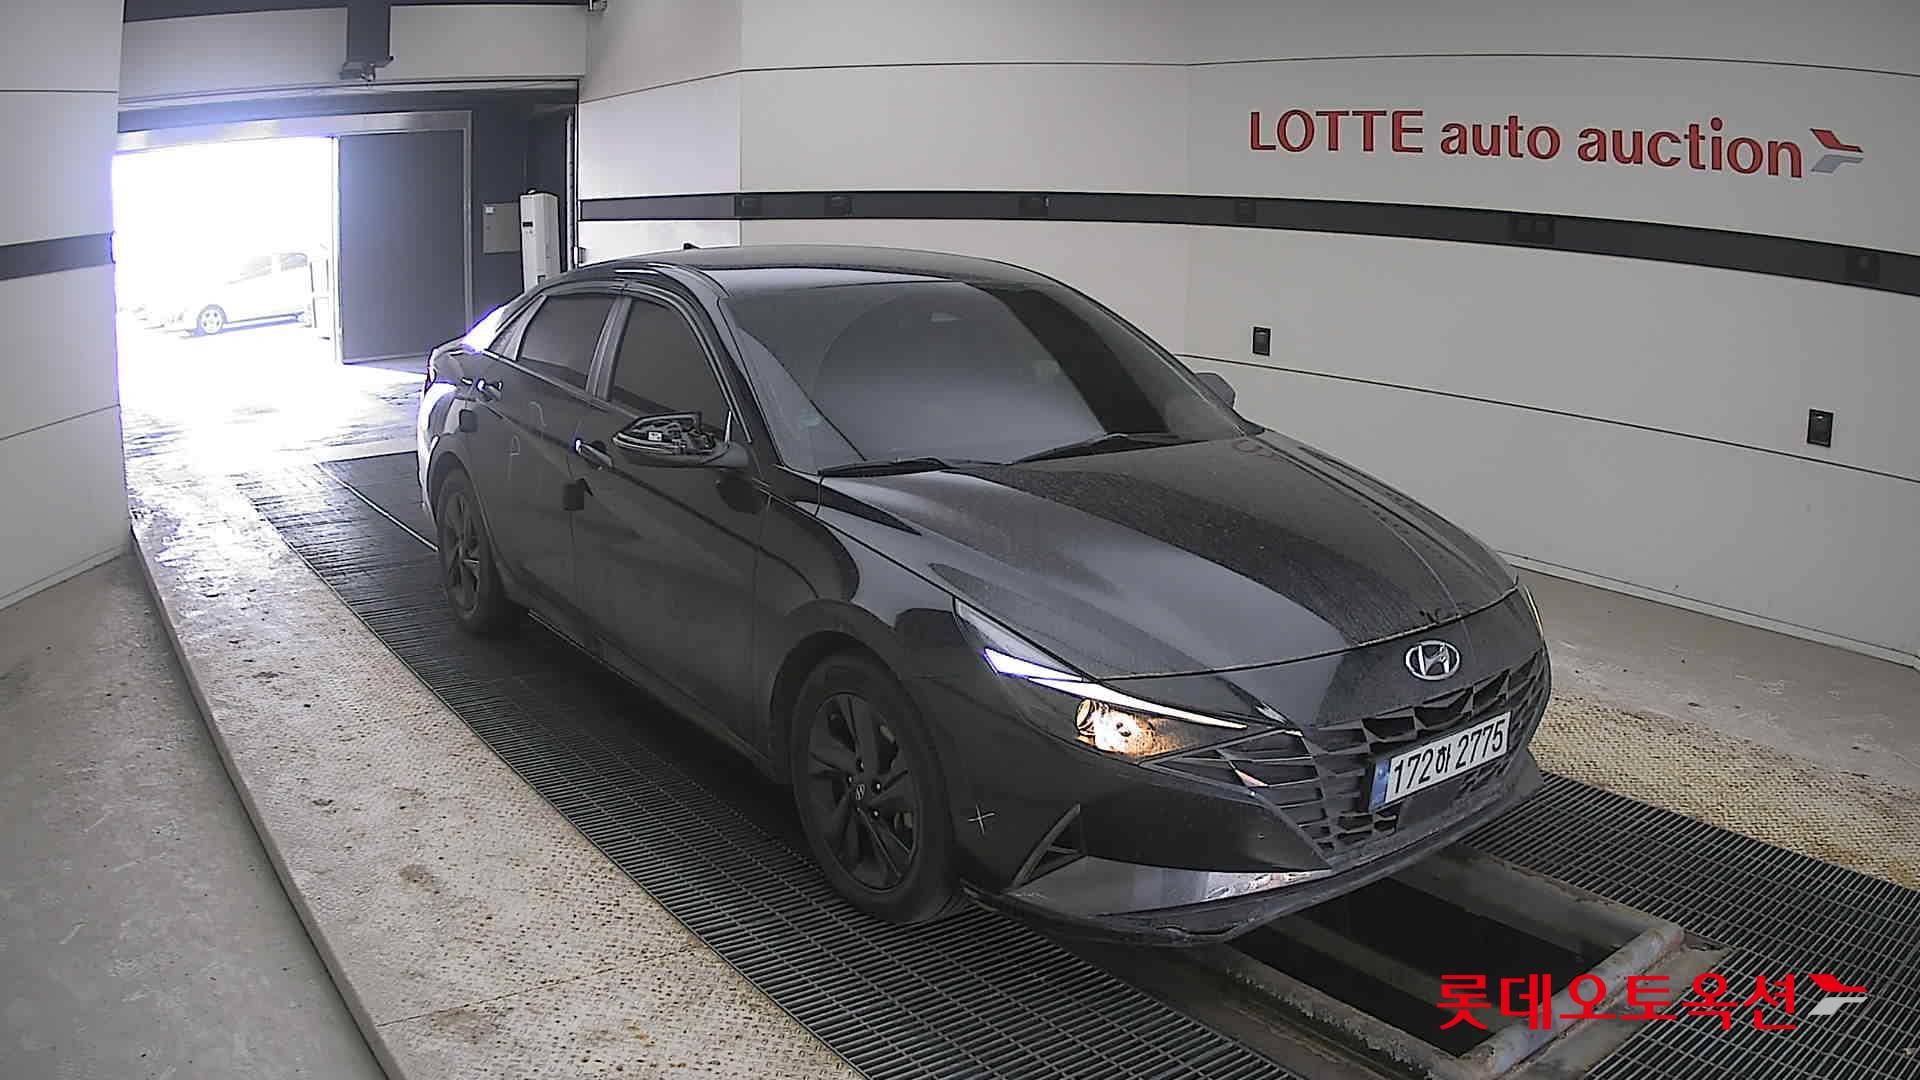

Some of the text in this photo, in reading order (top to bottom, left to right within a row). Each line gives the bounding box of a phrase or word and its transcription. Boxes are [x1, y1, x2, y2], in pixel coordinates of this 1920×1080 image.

[1249, 110, 1803, 179] LOTTE auto auction
[1394, 719, 1505, 793] 172하 2775
